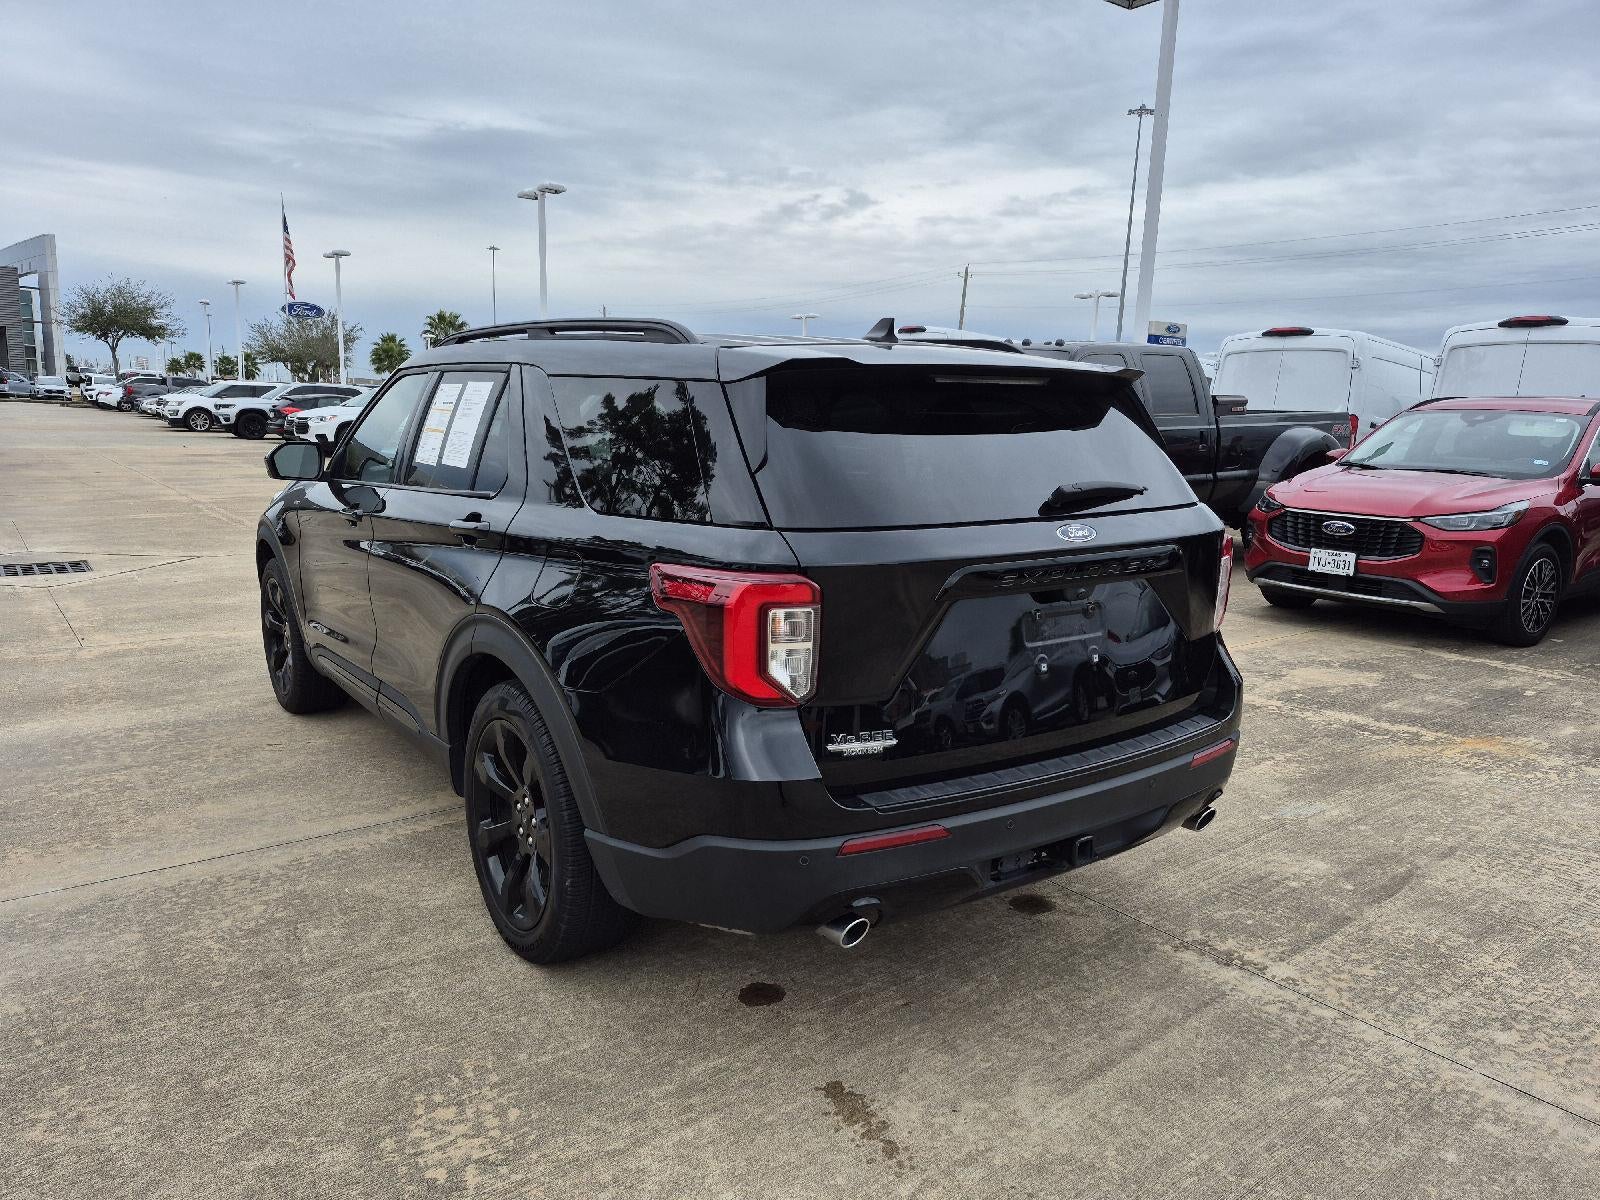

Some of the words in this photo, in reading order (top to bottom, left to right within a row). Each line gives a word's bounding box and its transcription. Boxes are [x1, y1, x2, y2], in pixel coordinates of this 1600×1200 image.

[290, 303, 318, 316] Ford
[1067, 525, 1089, 537] Ford
[994, 558, 1161, 588] EXPLORER
